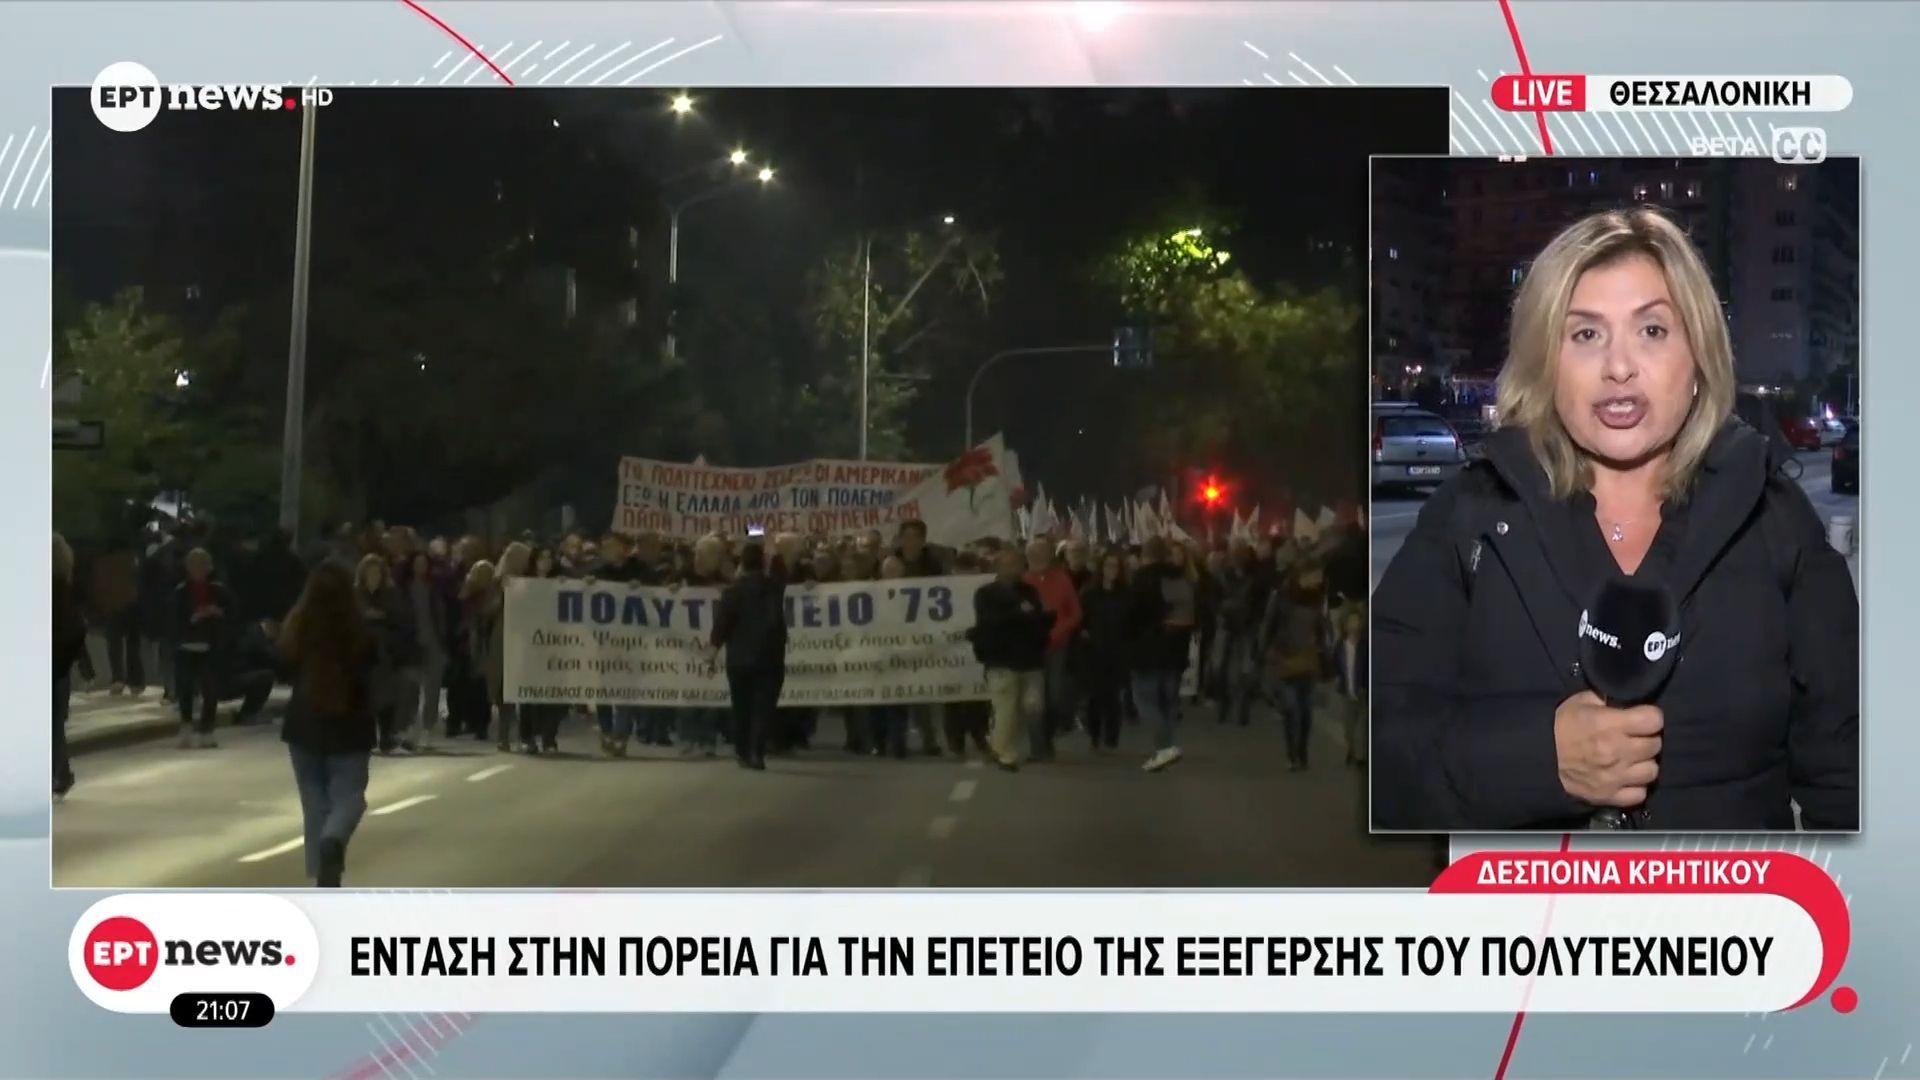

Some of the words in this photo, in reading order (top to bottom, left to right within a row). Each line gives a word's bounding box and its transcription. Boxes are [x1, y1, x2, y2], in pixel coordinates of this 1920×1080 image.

[659, 491, 670, 509] Η
[677, 493, 741, 512] ΕΛΛΑΔΑ
[791, 488, 819, 508] ΤΟΝ
[888, 586, 953, 623] '73
